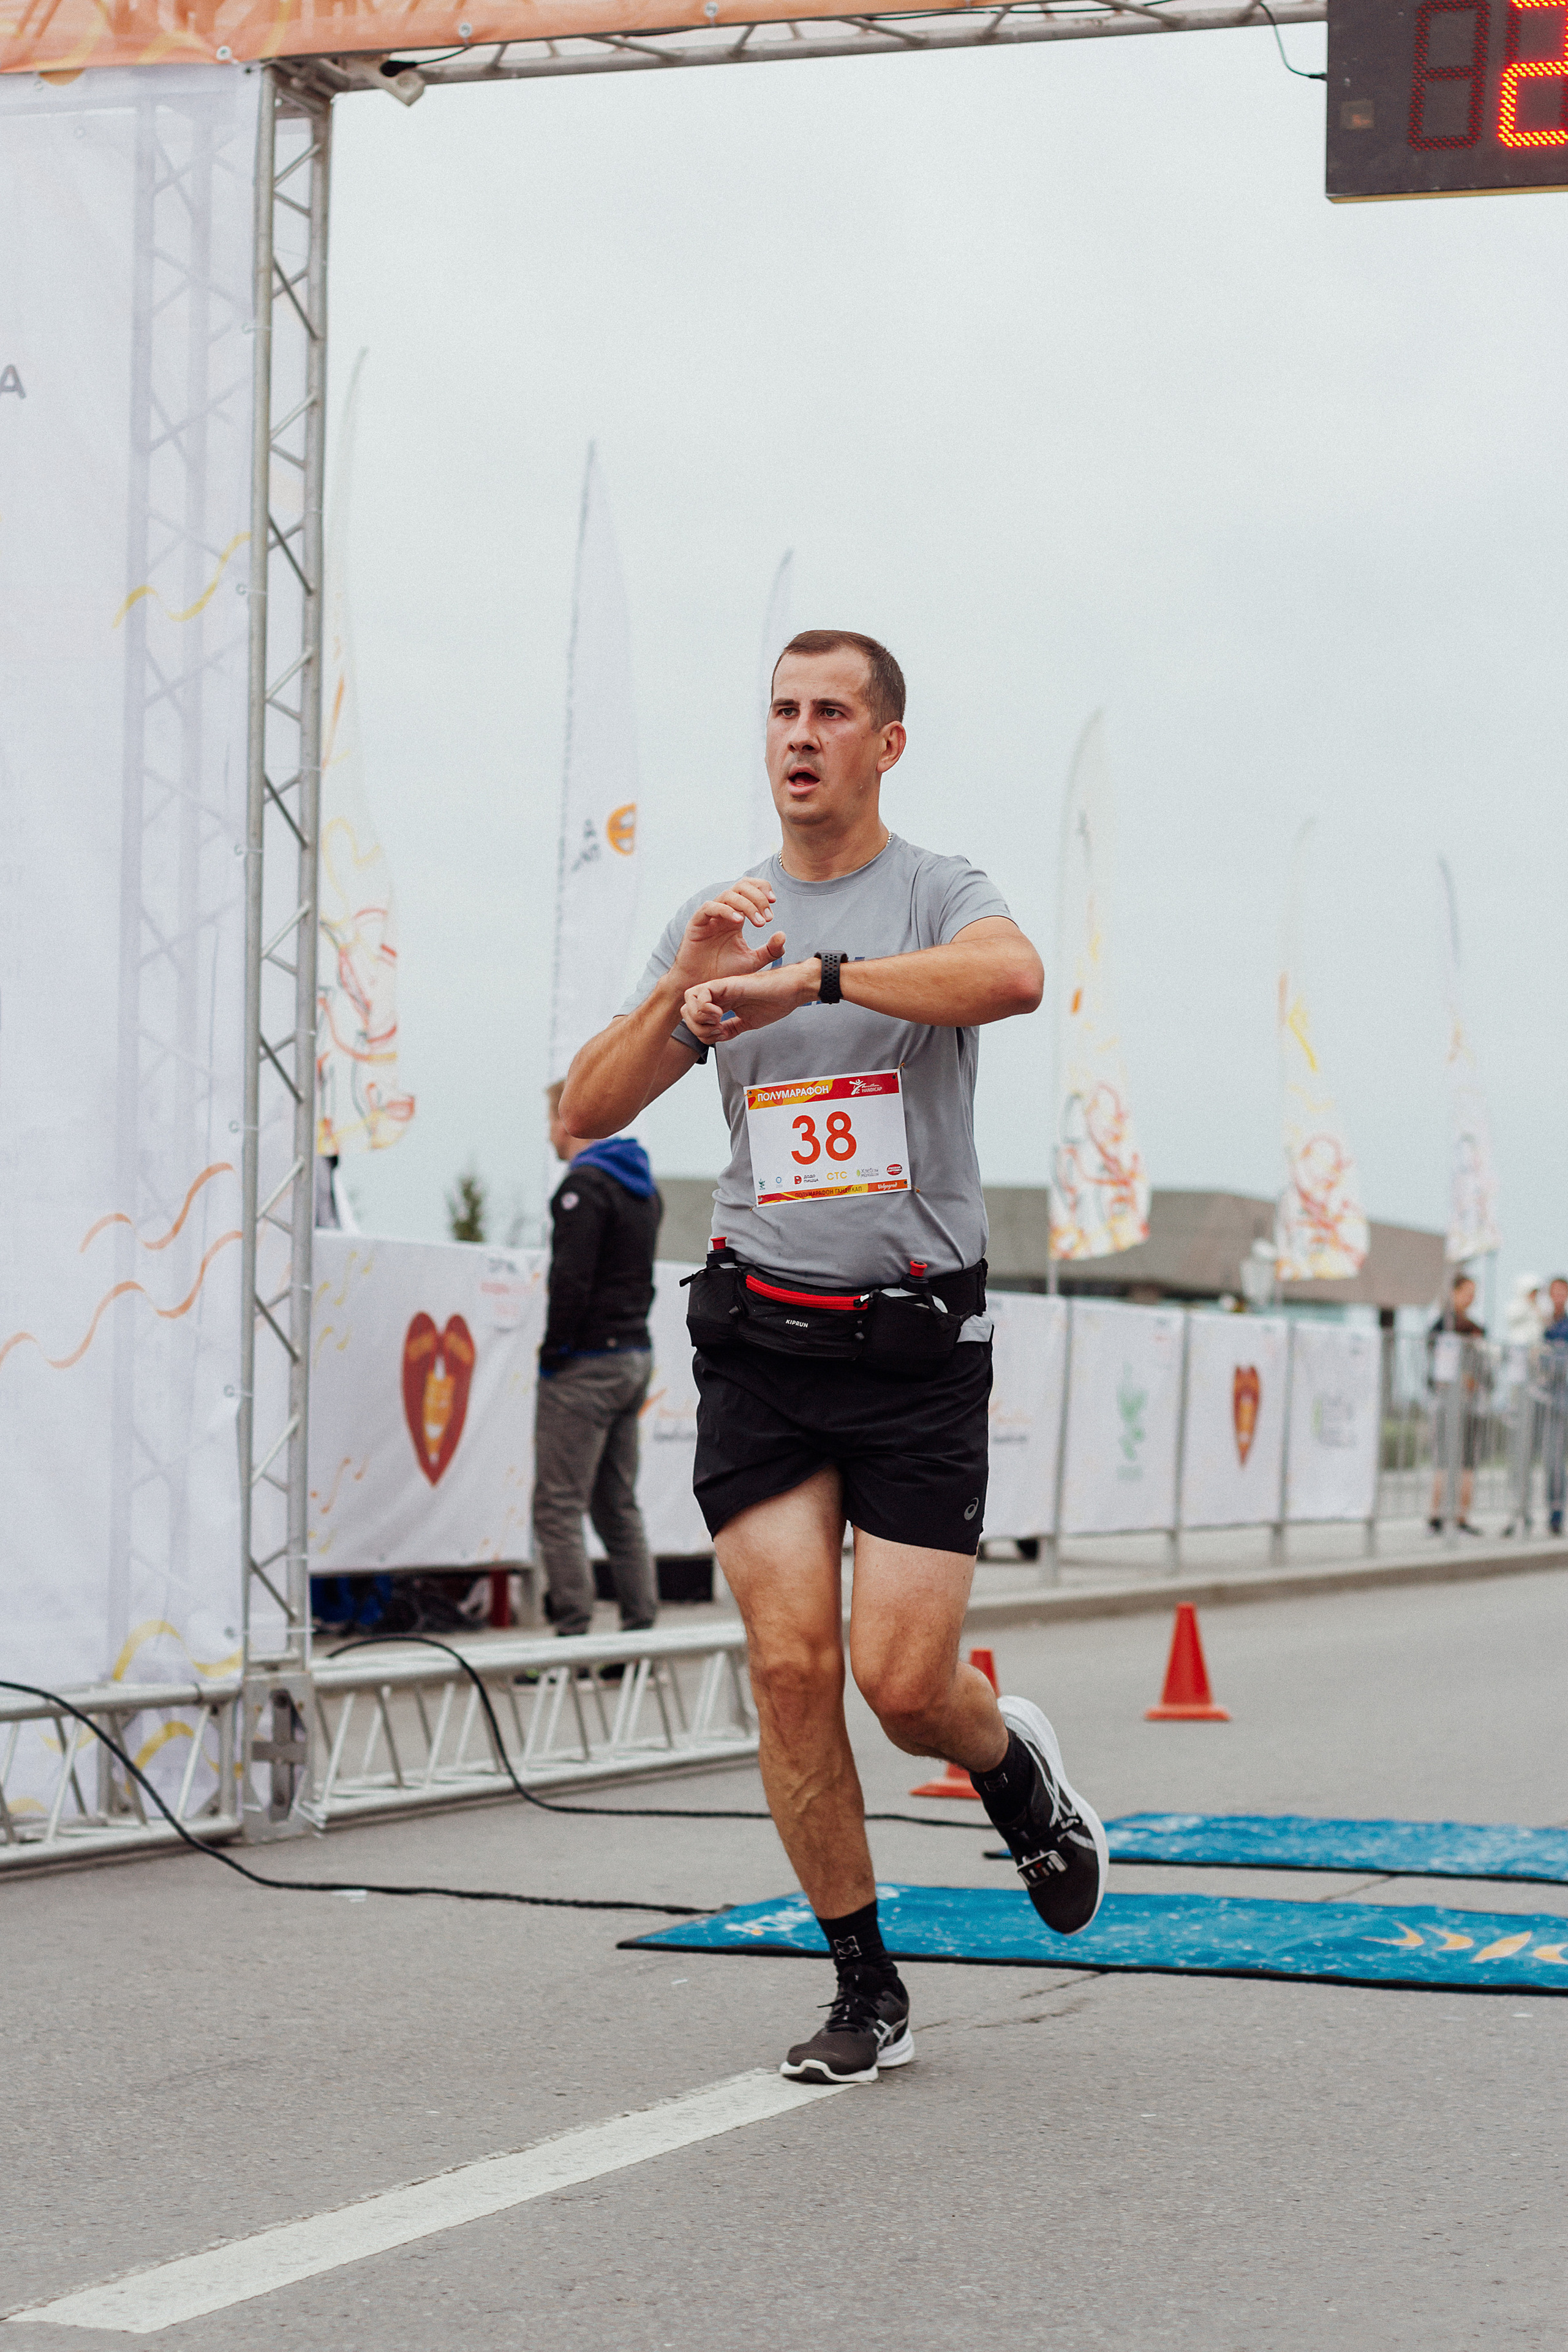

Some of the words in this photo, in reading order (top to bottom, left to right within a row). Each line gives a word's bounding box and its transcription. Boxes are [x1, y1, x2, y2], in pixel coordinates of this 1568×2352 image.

[758, 1085, 829, 1102] ПОЛУМАРАФОН
[791, 1111, 857, 1165] 38
[785, 1319, 809, 1328] KIPRUN
